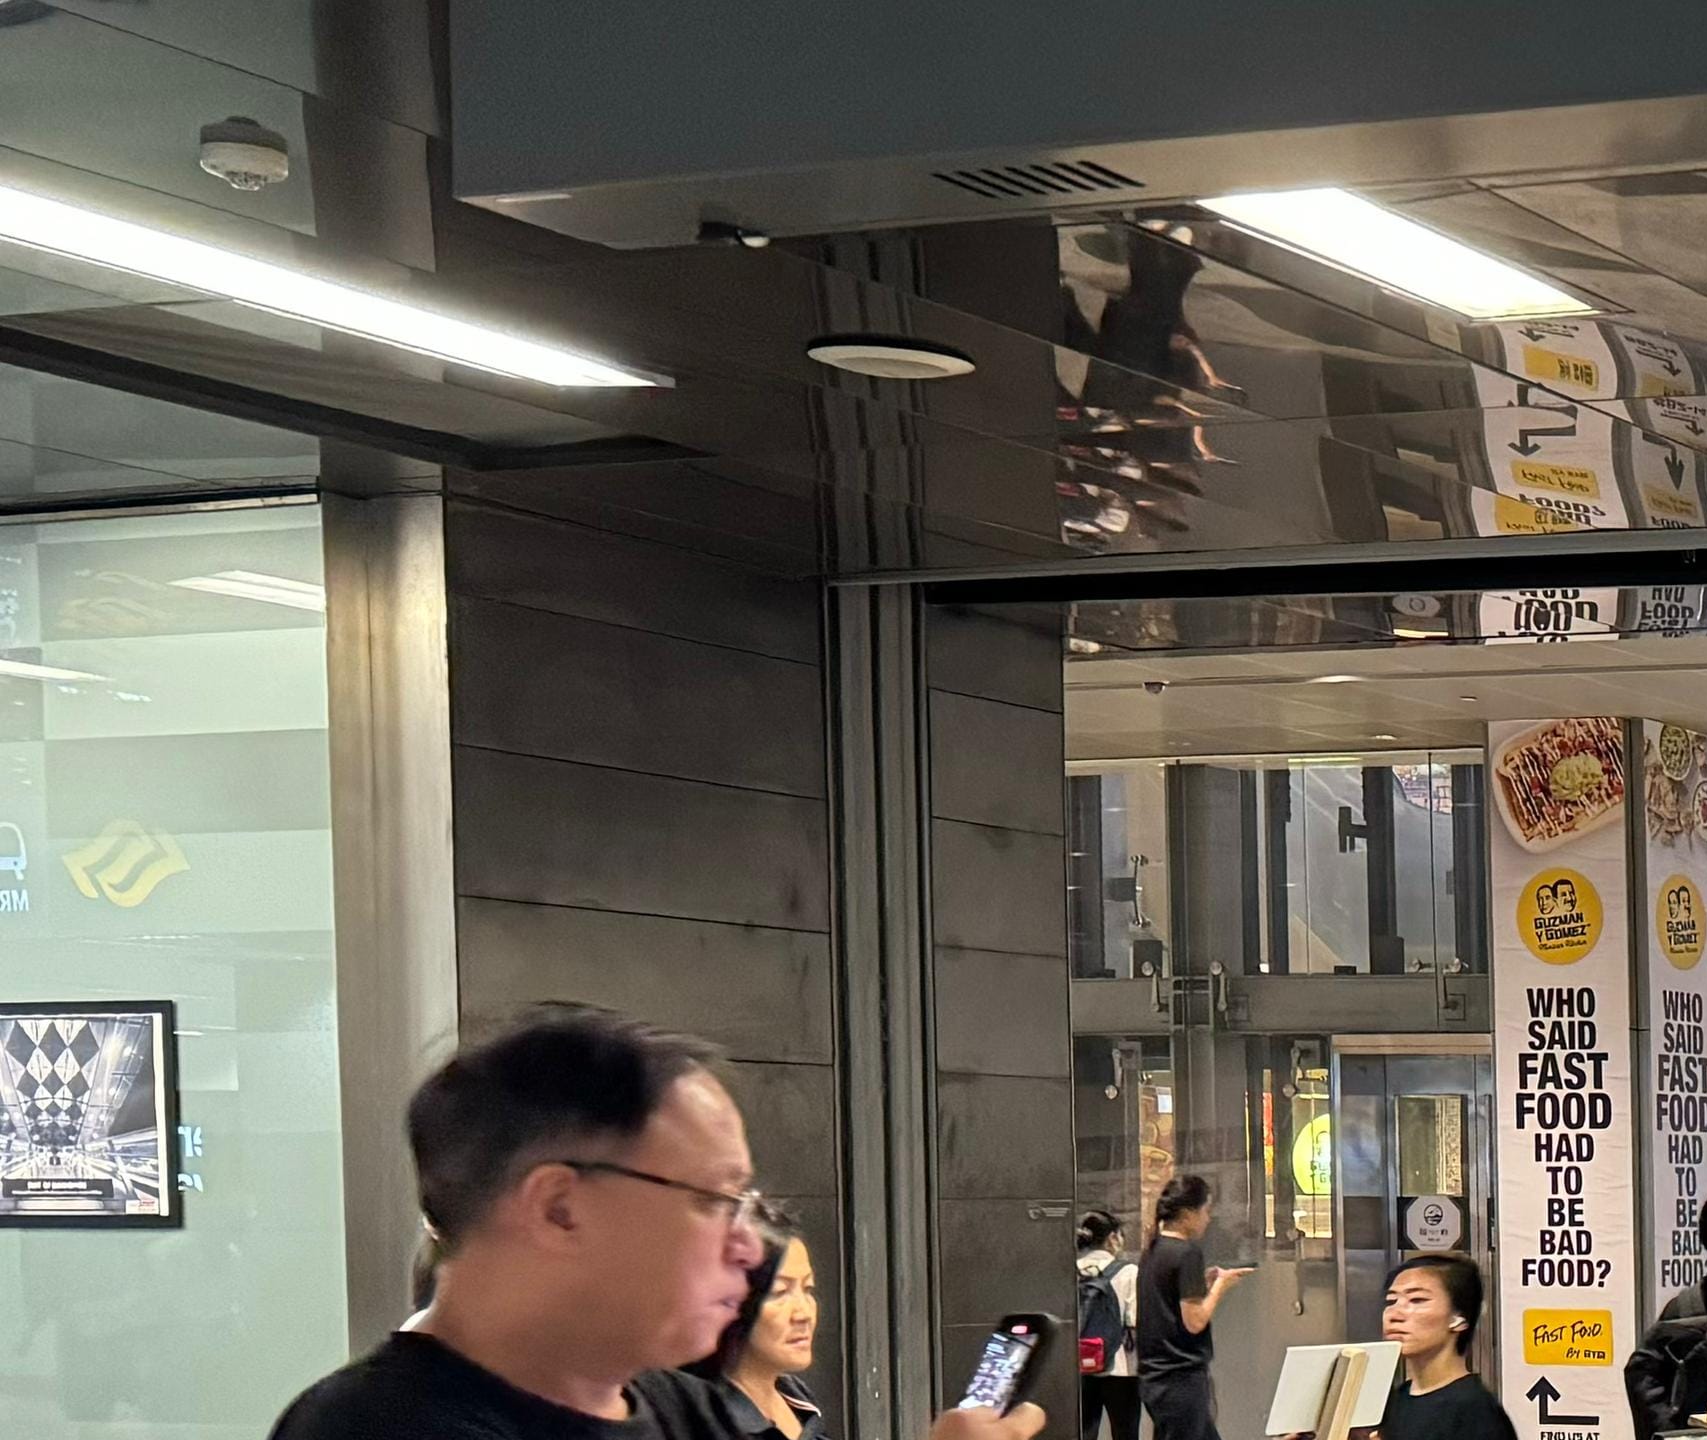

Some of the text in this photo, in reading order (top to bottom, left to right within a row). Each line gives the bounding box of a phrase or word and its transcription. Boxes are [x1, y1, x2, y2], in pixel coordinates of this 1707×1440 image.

[1533, 912, 1584, 930] GUZMAN
[1535, 930, 1543, 943] Y
[1526, 987, 1596, 1018] WHO
[1662, 990, 1703, 1022] WHO
[1528, 1020, 1596, 1051] SAID
[1664, 1026, 1703, 1055] SAID
[1518, 1052, 1609, 1090] FAST
[1516, 1093, 1612, 1130] FOOD
[1535, 1133, 1594, 1162] HAD
[1668, 1134, 1703, 1165] HAD
[1546, 1166, 1583, 1196] TO
[1675, 1167, 1696, 1197] TO
[1547, 1198, 1584, 1227] BE
[1676, 1199, 1698, 1228] BE
[1540, 1230, 1592, 1256] BAD
[1672, 1230, 1701, 1257] BAD
[1522, 1258, 1611, 1288] FOOD?
